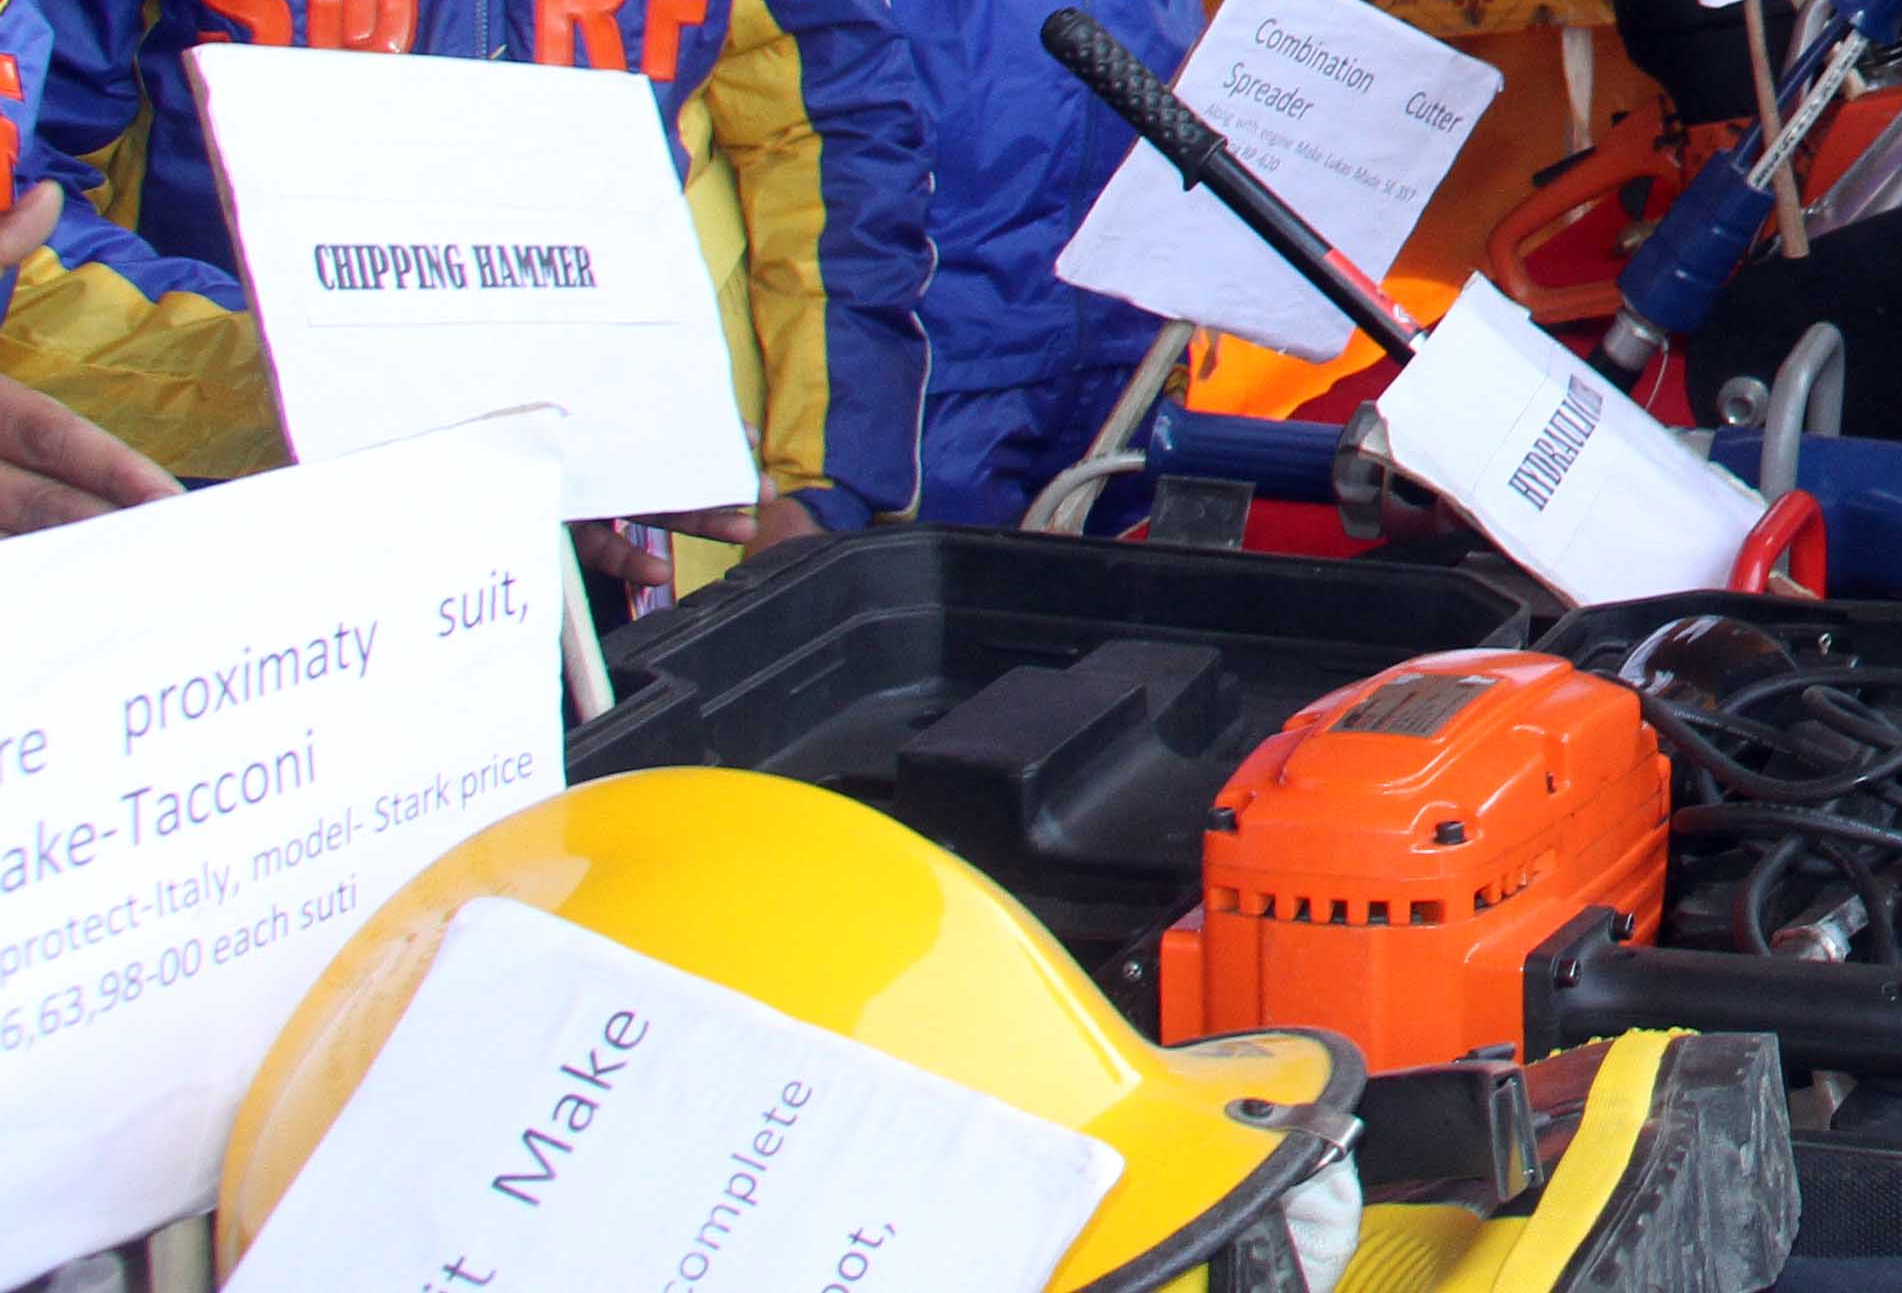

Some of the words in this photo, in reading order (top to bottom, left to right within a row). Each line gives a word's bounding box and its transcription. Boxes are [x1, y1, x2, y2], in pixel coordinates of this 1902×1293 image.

[1223, 61, 1315, 122] Spreader
[1254, 18, 1376, 95] Combination
[1405, 91, 1465, 134] Cutter
[313, 243, 466, 291] CHIPPING
[472, 244, 598, 290] HAMMER
[121, 620, 378, 756] proximaty
[437, 570, 530, 639] suit,
[0, 728, 317, 895] ake-Tacconi
[373, 773, 451, 835] Stark
[460, 748, 534, 809] price
[212, 904, 290, 965] each
[301, 873, 358, 932] suti
[491, 1009, 650, 1207] Make
